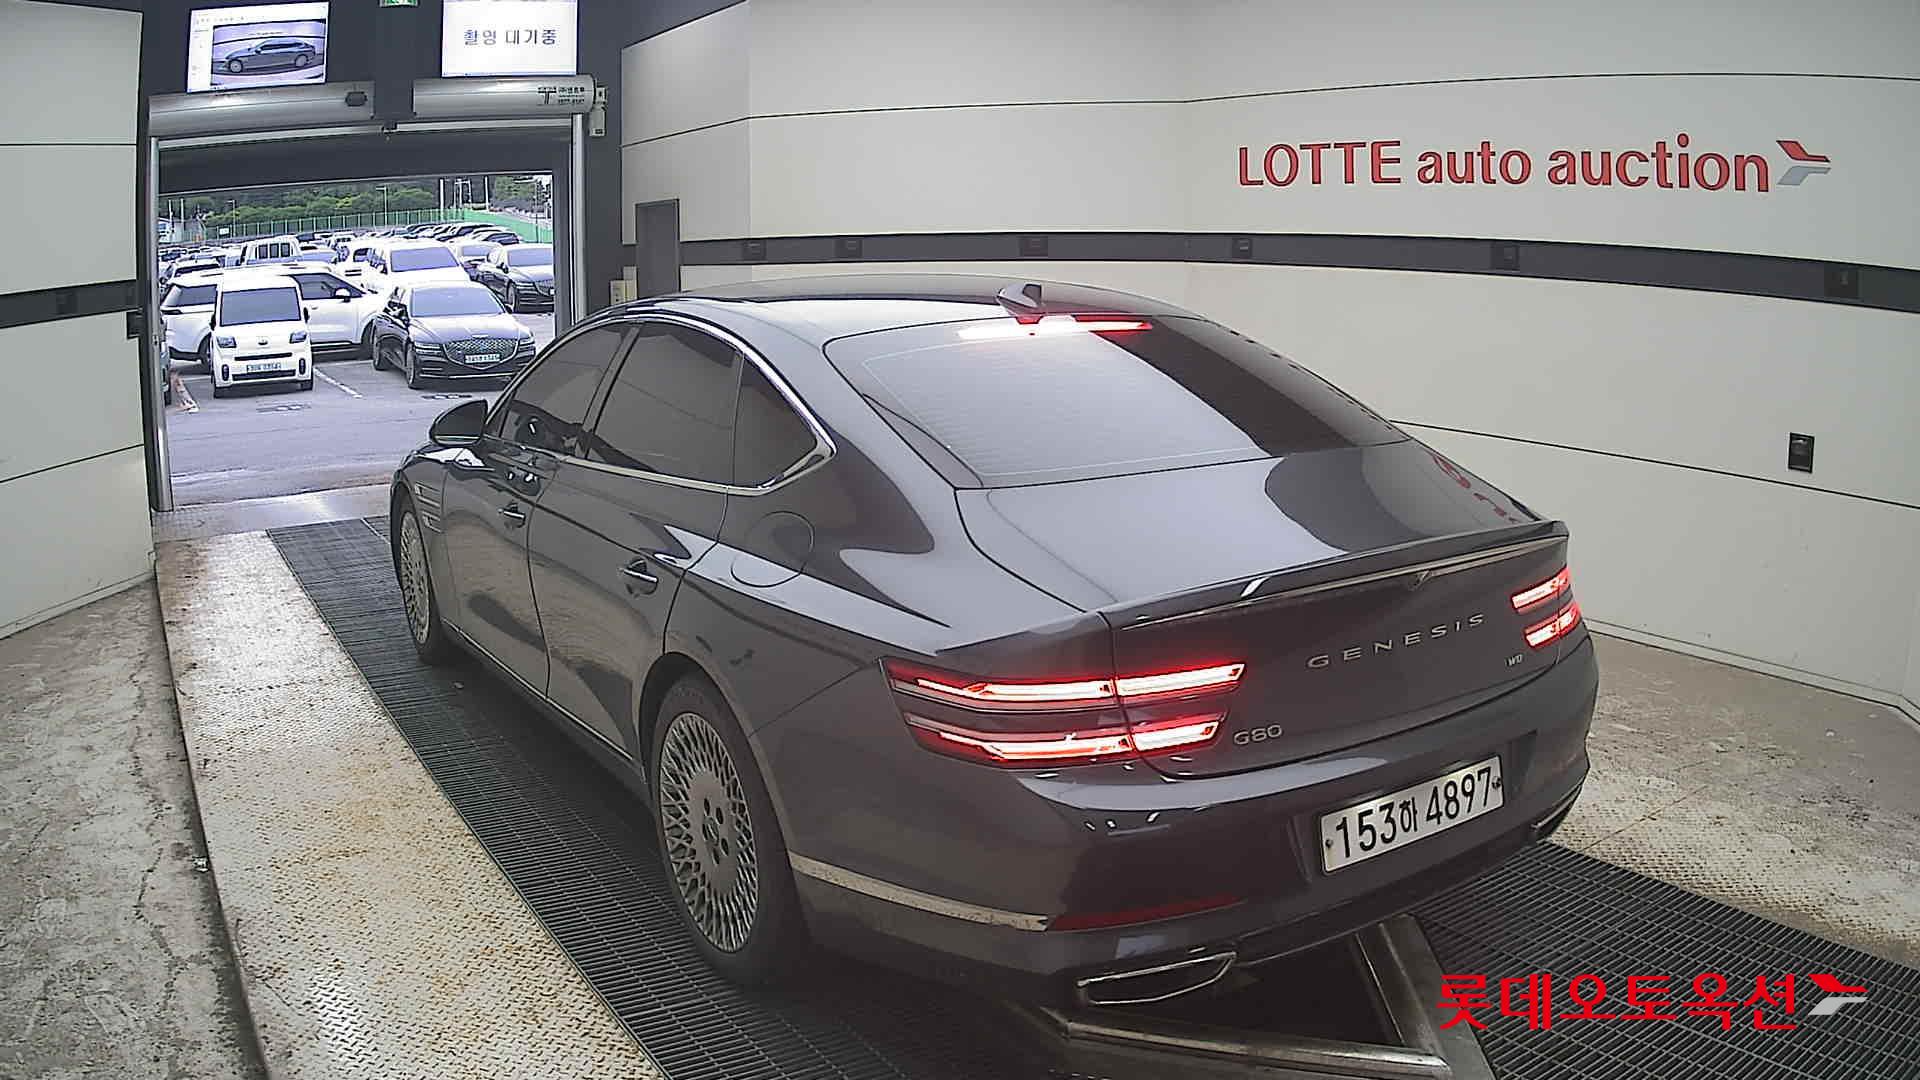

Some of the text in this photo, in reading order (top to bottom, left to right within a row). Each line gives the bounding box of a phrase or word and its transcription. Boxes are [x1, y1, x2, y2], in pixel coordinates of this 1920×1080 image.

[505, 28, 559, 46] 대기중
[1238, 132, 1770, 193] LOTTE auto auction
[1306, 612, 1486, 669] GENESIS
[1233, 724, 1283, 746] G80
[1335, 765, 1493, 859] 153하 4897
